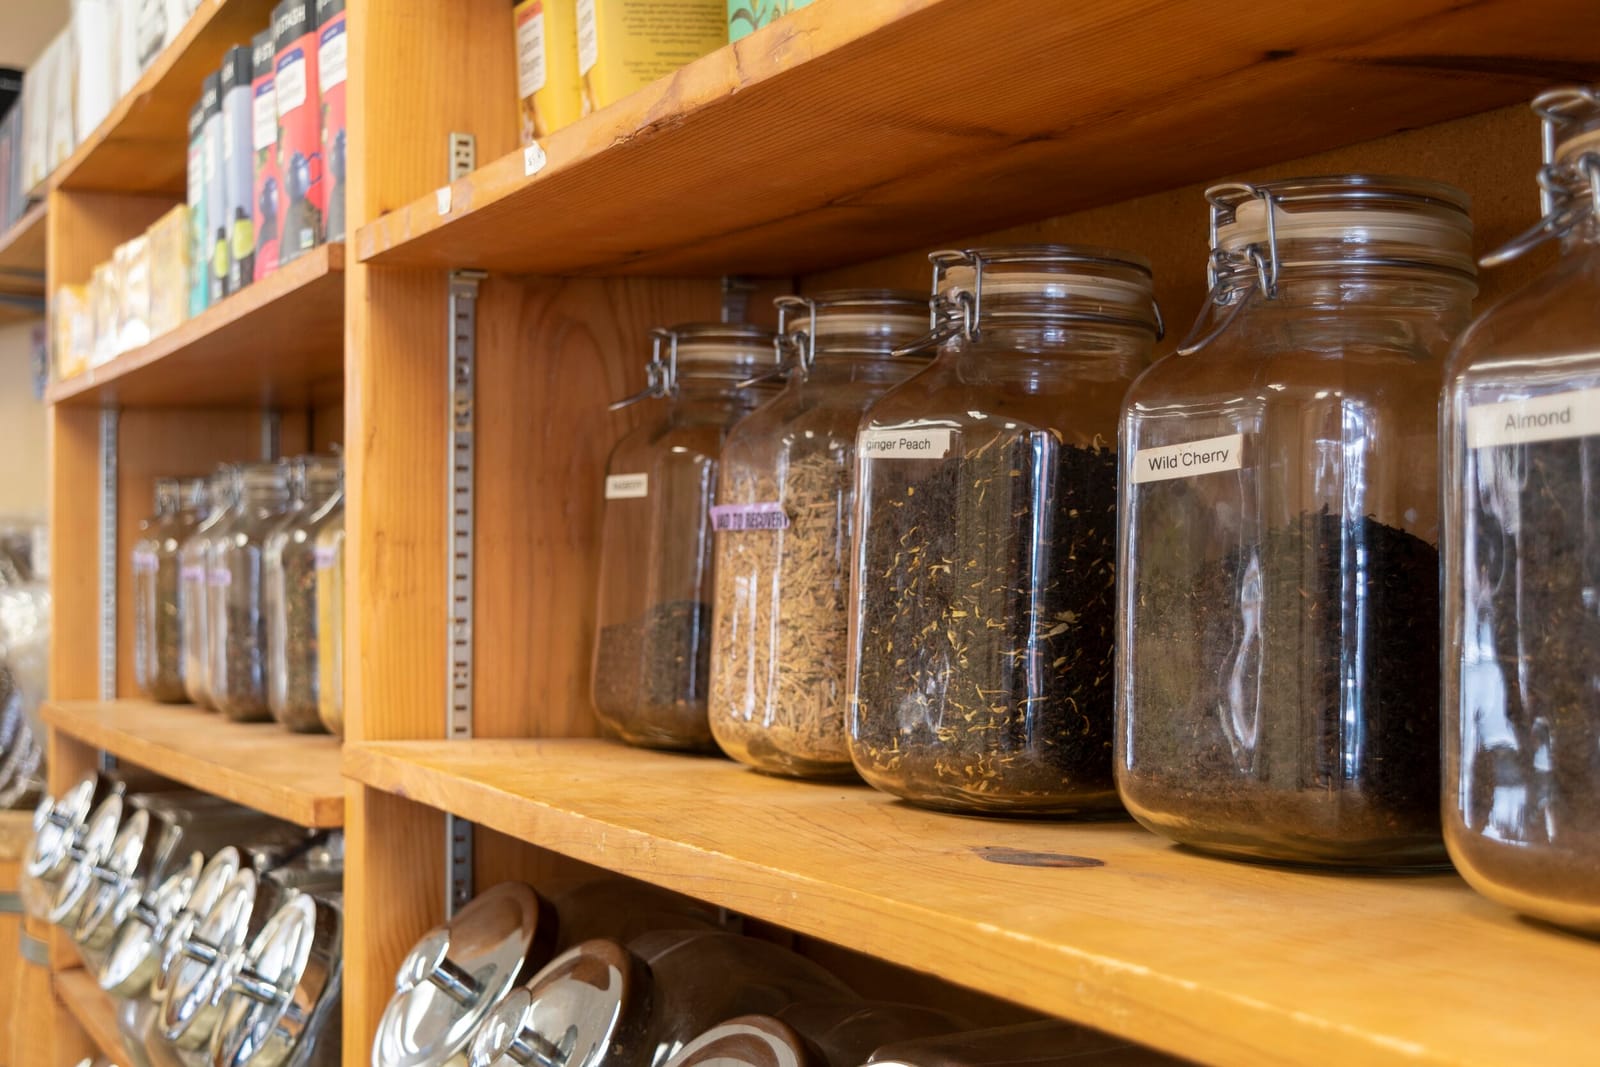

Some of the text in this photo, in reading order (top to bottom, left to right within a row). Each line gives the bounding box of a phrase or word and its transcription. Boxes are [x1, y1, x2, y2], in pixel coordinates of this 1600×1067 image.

[1504, 407, 1571, 431] Almond
[899, 438, 931, 450] Peach
[1148, 449, 1229, 471] Wild Cherry
